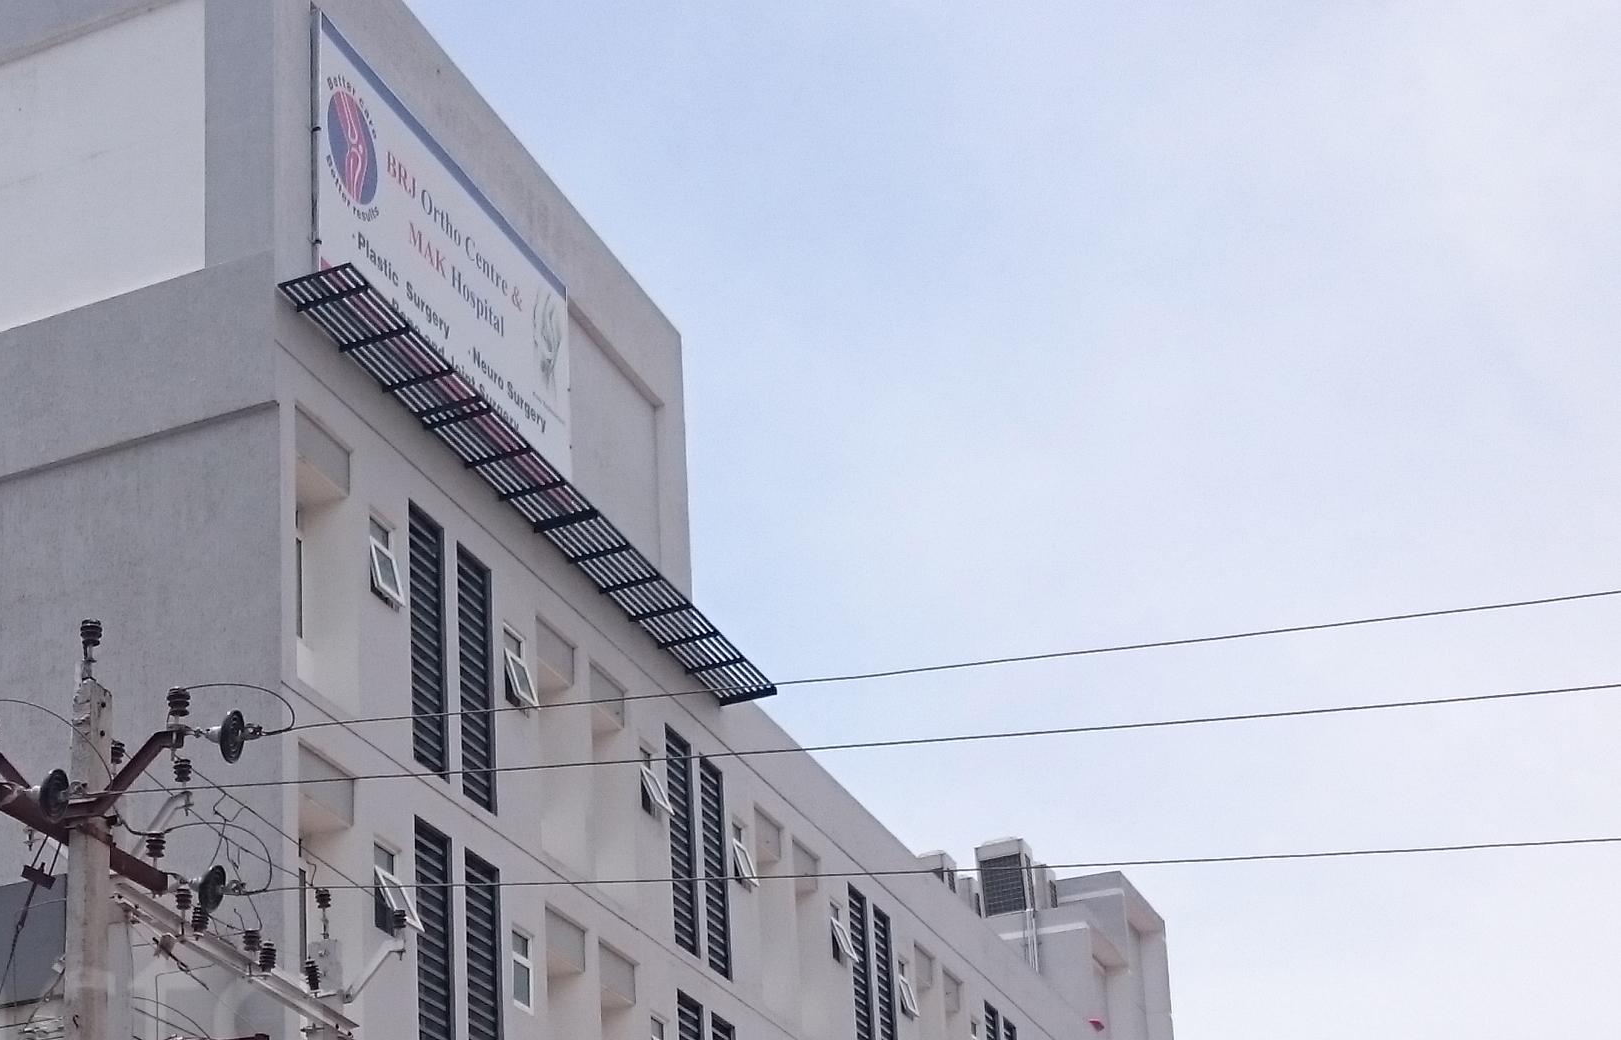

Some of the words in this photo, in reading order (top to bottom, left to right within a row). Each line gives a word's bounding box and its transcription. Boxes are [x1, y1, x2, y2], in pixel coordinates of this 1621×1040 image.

[352, 206, 380, 222] results
[386, 150, 416, 199] BRJ
[421, 189, 462, 246] Ortho
[466, 236, 508, 294] Centre
[511, 286, 522, 312] &
[357, 231, 399, 287] Plastic
[406, 281, 450, 339] Surgery
[409, 222, 447, 279] MAK
[452, 266, 505, 337] Hospital
[473, 347, 504, 391] Neuro
[507, 381, 547, 433] Surgery
